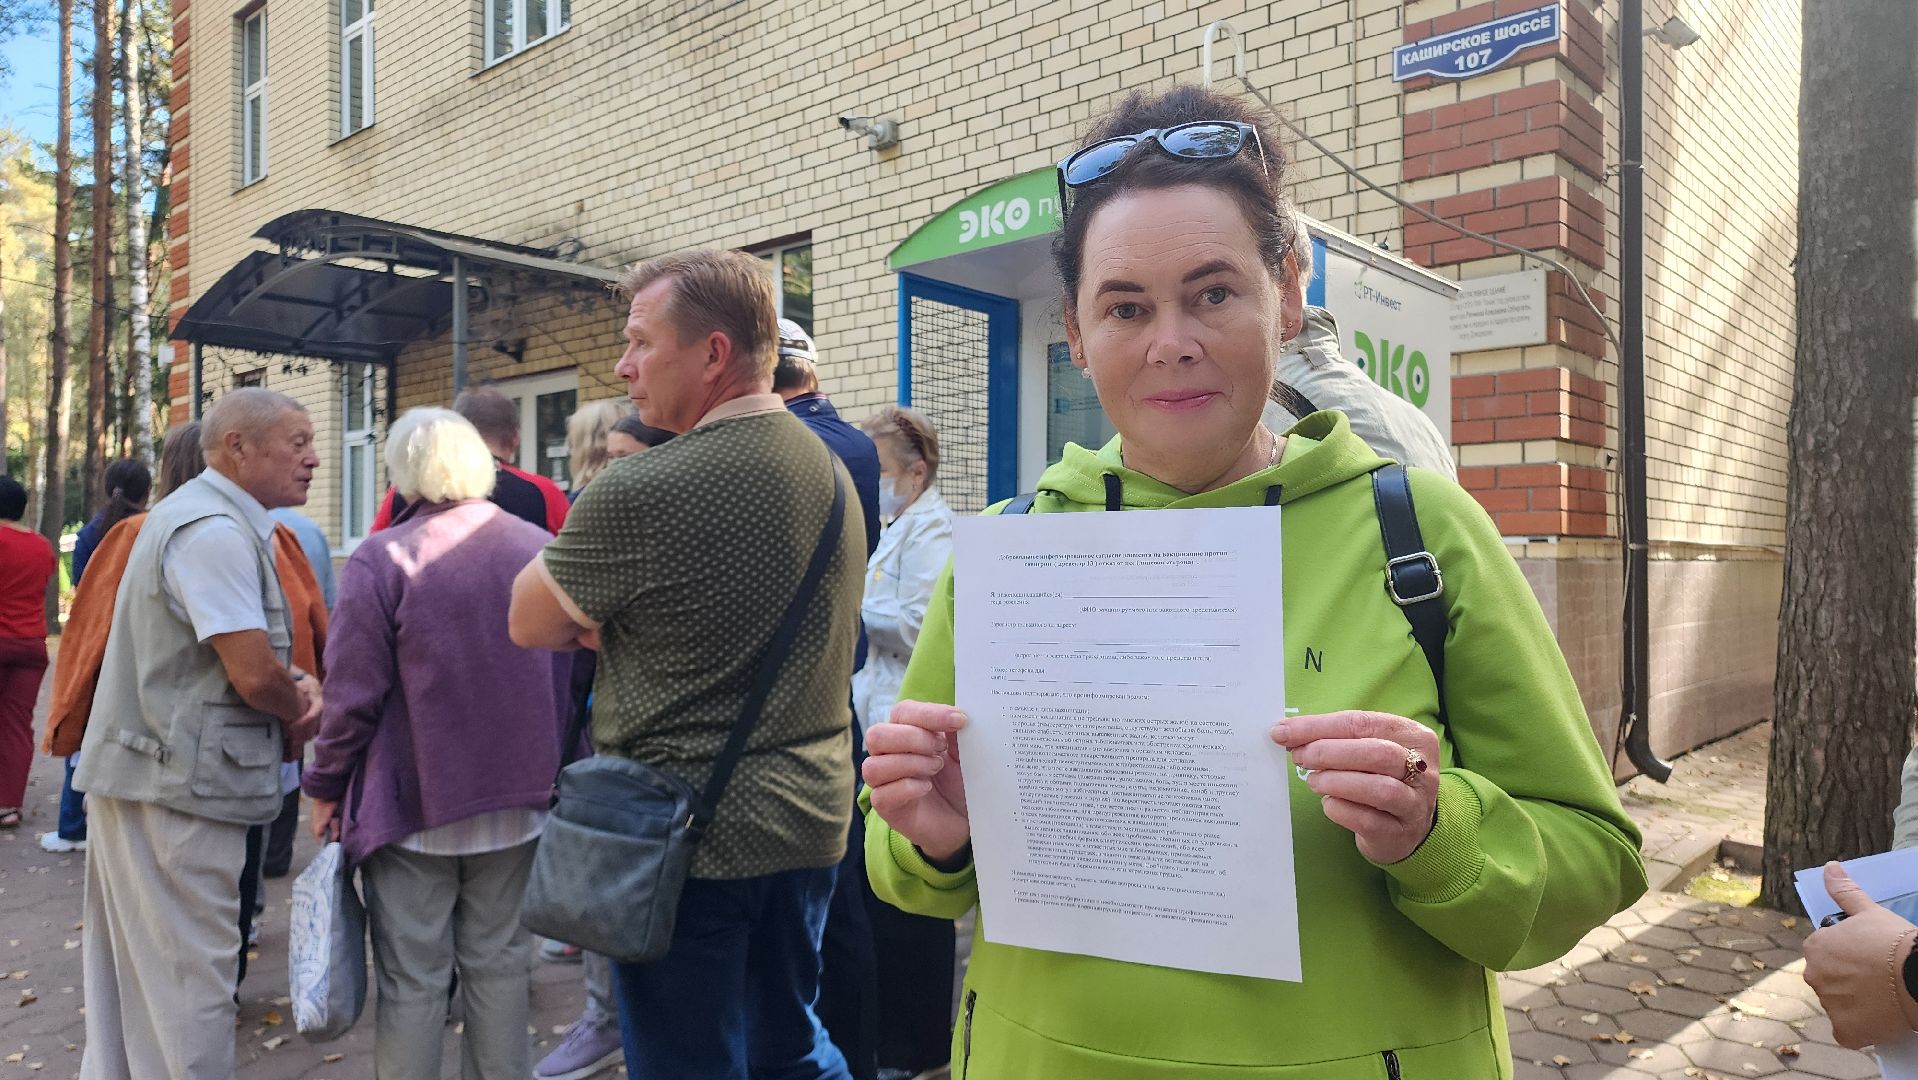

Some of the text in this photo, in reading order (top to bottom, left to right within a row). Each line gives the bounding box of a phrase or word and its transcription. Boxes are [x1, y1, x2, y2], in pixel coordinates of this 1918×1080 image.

[1401, 15, 1551, 66] КАШИРСКОЕ ШОССЕ
[1454, 48, 1493, 71] 107
[959, 197, 1030, 243] ЭКО
[1354, 330, 1430, 410] ЭКО
